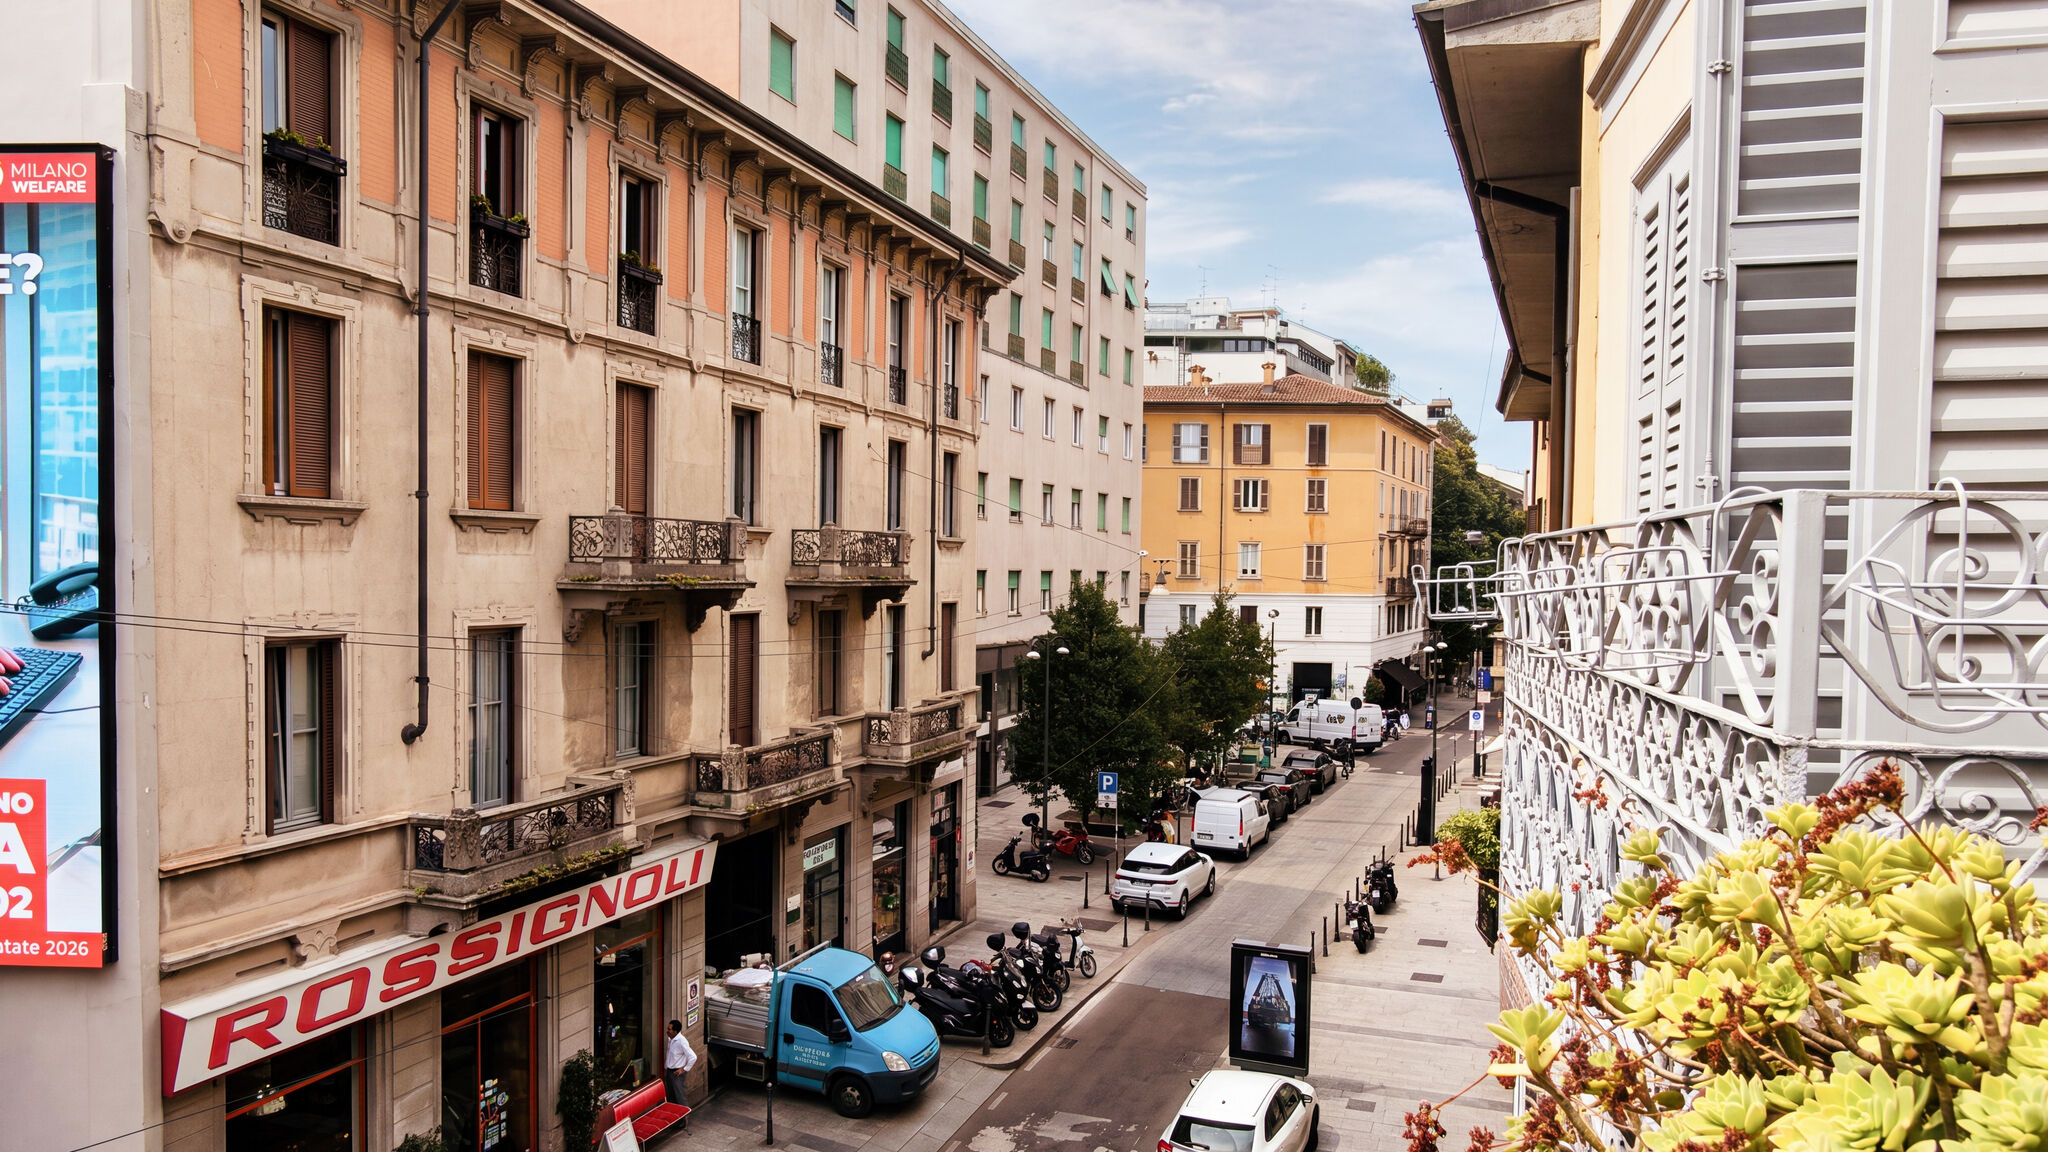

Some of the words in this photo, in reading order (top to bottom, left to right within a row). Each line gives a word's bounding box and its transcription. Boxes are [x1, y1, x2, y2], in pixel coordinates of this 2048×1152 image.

[11, 163, 87, 178] MILANO
[11, 180, 87, 193] WELFARE
[1102, 775, 1113, 790] P
[45, 940, 89, 956] 2026
[207, 848, 704, 1070] ROSSIGNOLI
